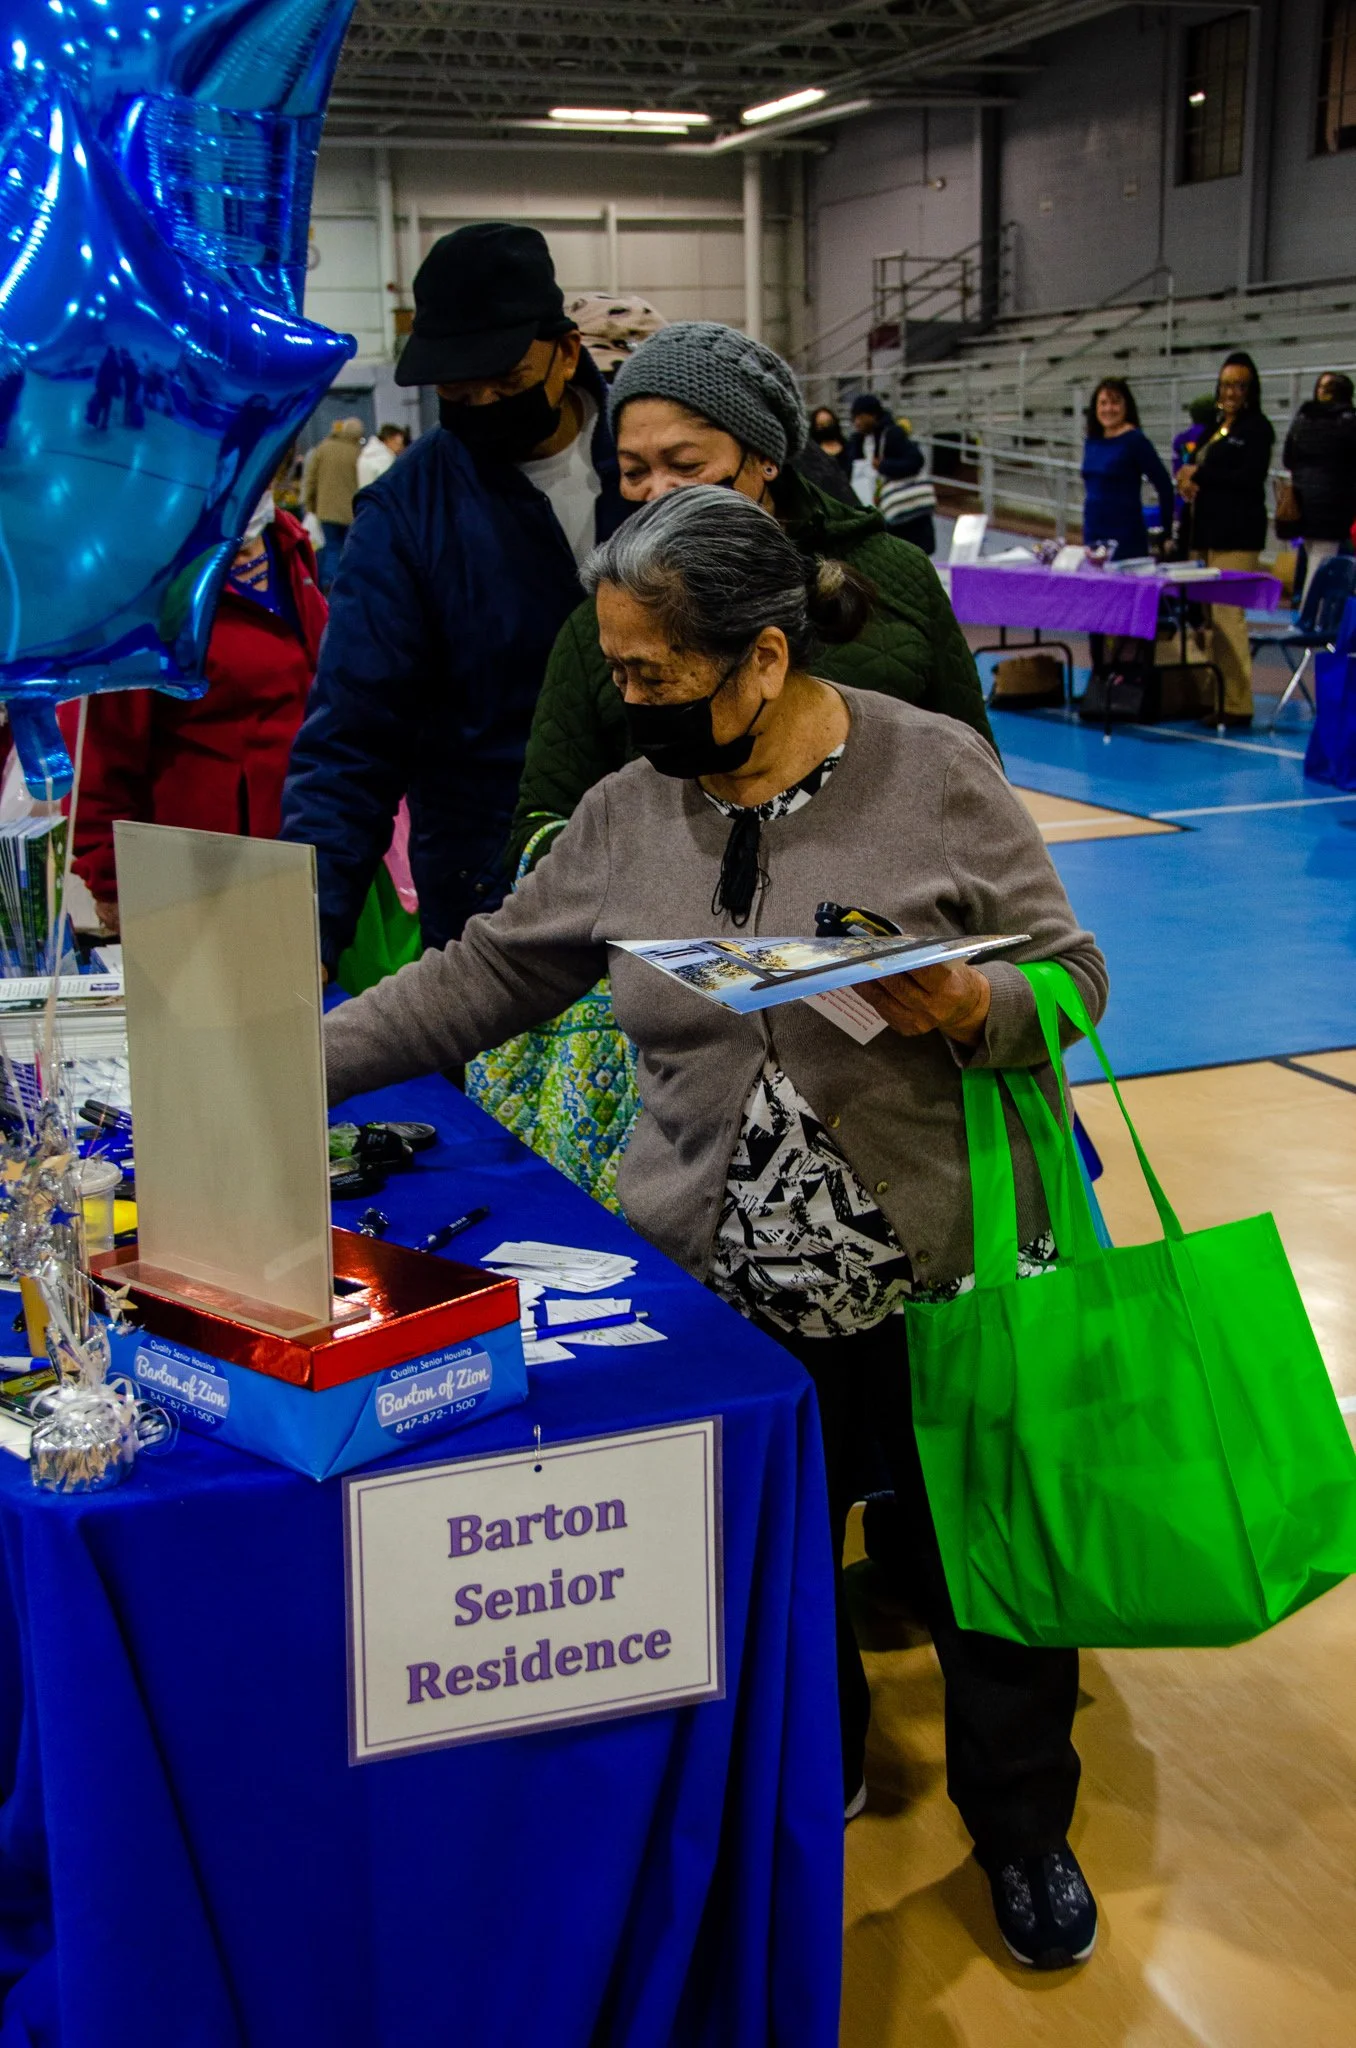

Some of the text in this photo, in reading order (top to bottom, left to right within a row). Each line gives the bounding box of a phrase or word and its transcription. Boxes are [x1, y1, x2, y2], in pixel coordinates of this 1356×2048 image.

[136, 1354, 228, 1408] Barton of Zion
[150, 1340, 216, 1374] Quality Senior Housing
[390, 1347, 472, 1380] Quality Senior Housing
[150, 1391, 216, 1425] 847-872-1500
[378, 1367, 490, 1417] Barton of Zion
[395, 1398, 476, 1434] 847-872-1500
[447, 1498, 628, 1559] Barton
[454, 1567, 625, 1627] Senior
[405, 1626, 673, 1705] Residence
